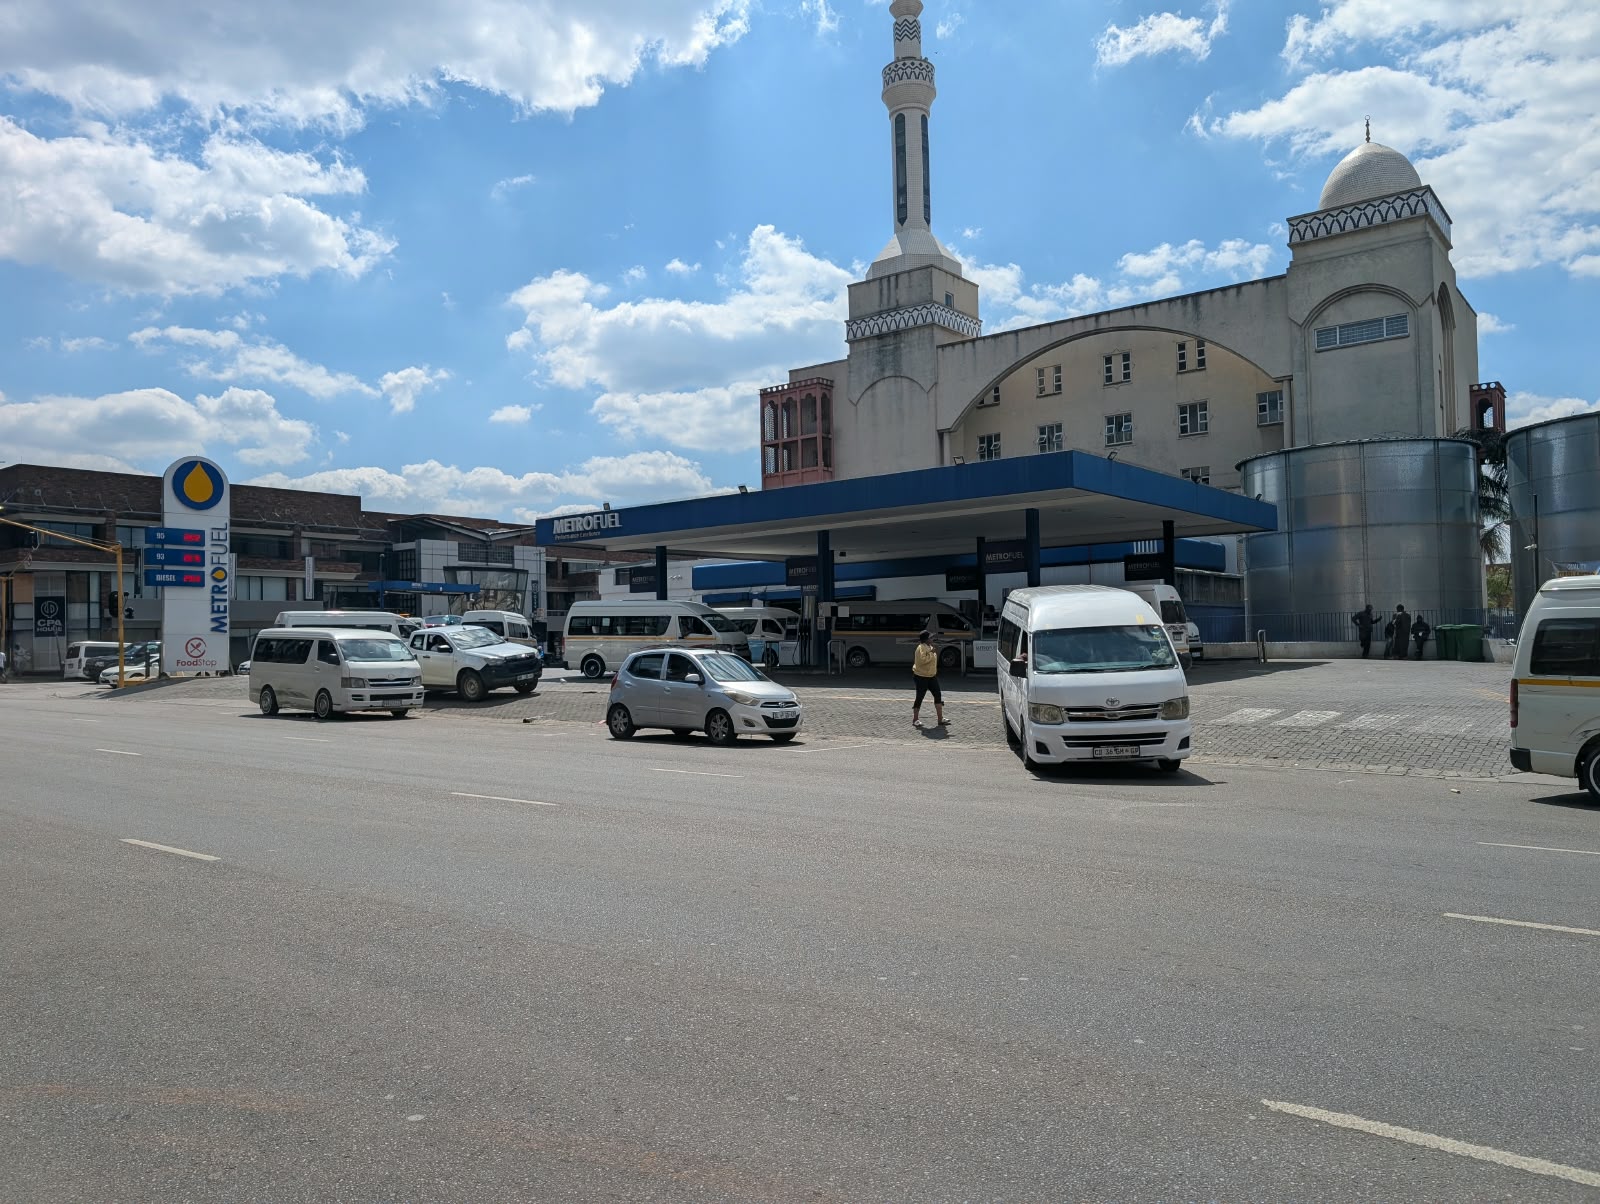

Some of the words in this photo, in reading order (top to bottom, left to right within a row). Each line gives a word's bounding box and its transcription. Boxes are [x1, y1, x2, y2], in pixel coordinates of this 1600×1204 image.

[553, 513, 622, 534] METROFUEL
[985, 551, 1025, 561] METROFUEL
[156, 574, 176, 582] DIESEL
[210, 522, 228, 633] METROFUEL
[37, 619, 62, 627] CPA
[176, 659, 217, 667] FoodStop
